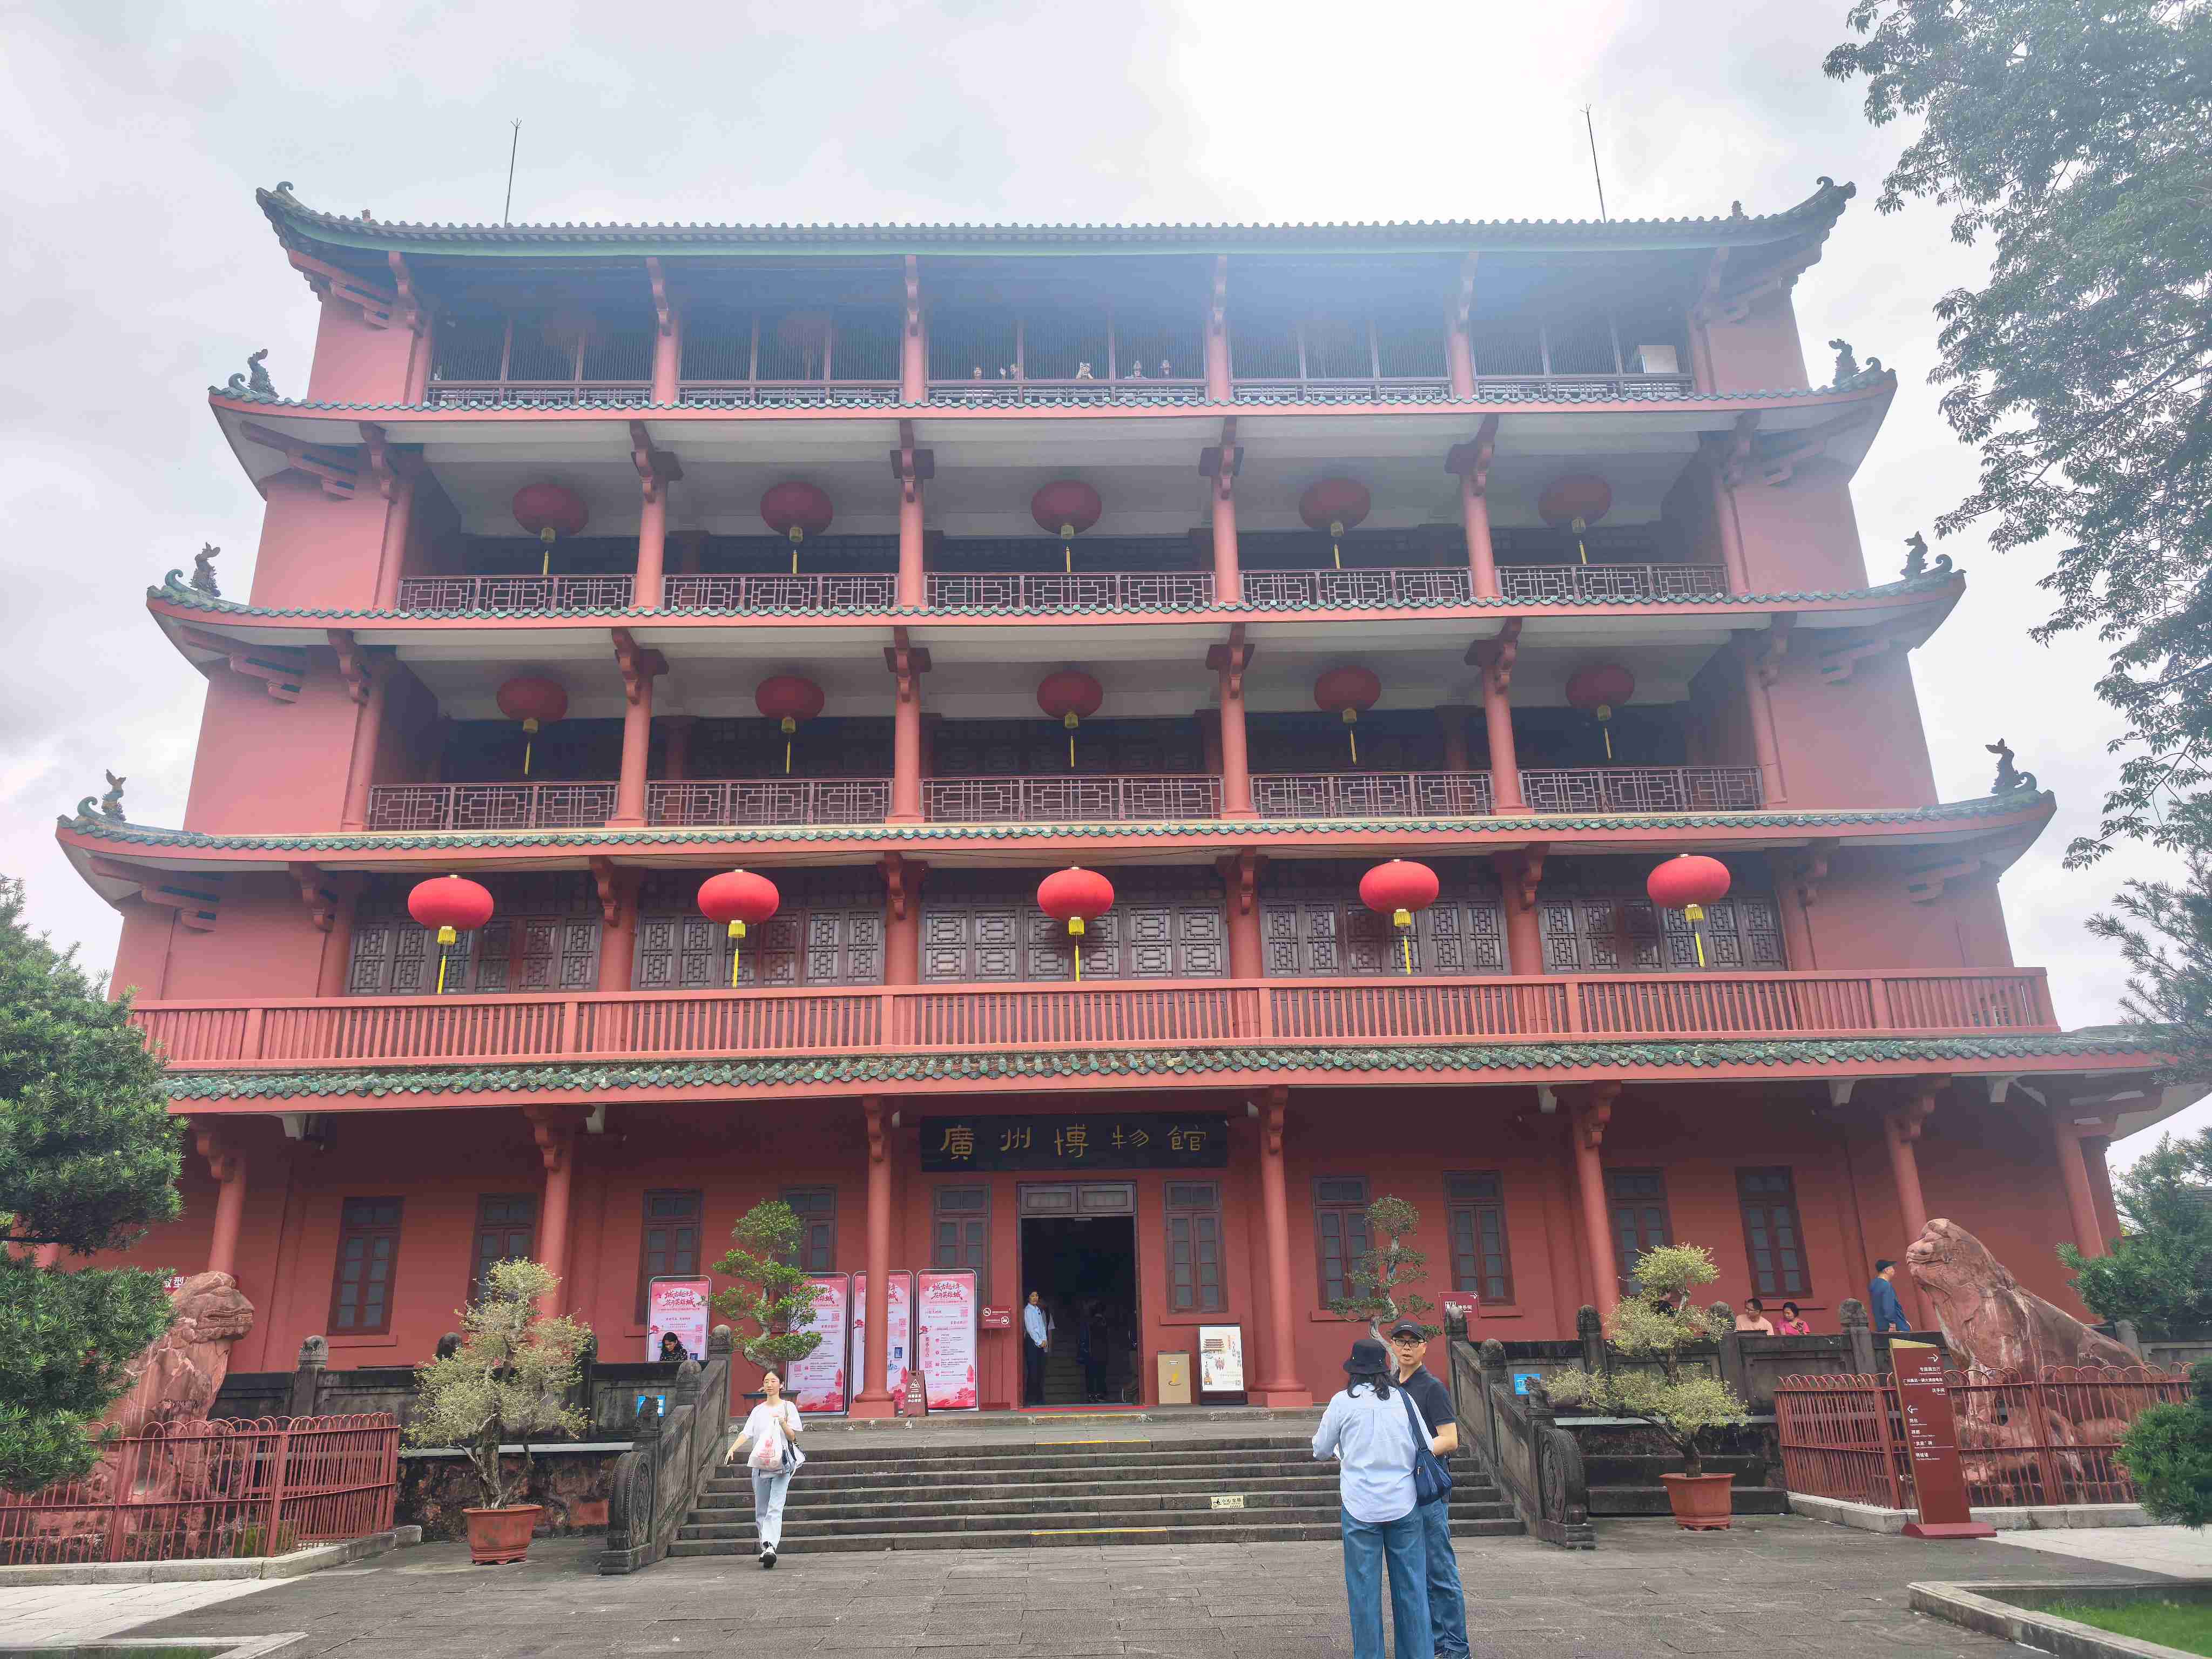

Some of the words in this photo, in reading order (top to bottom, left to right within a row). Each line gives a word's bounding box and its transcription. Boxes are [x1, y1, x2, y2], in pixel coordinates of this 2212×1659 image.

[939, 1124, 1206, 1161] 廣州博物館
